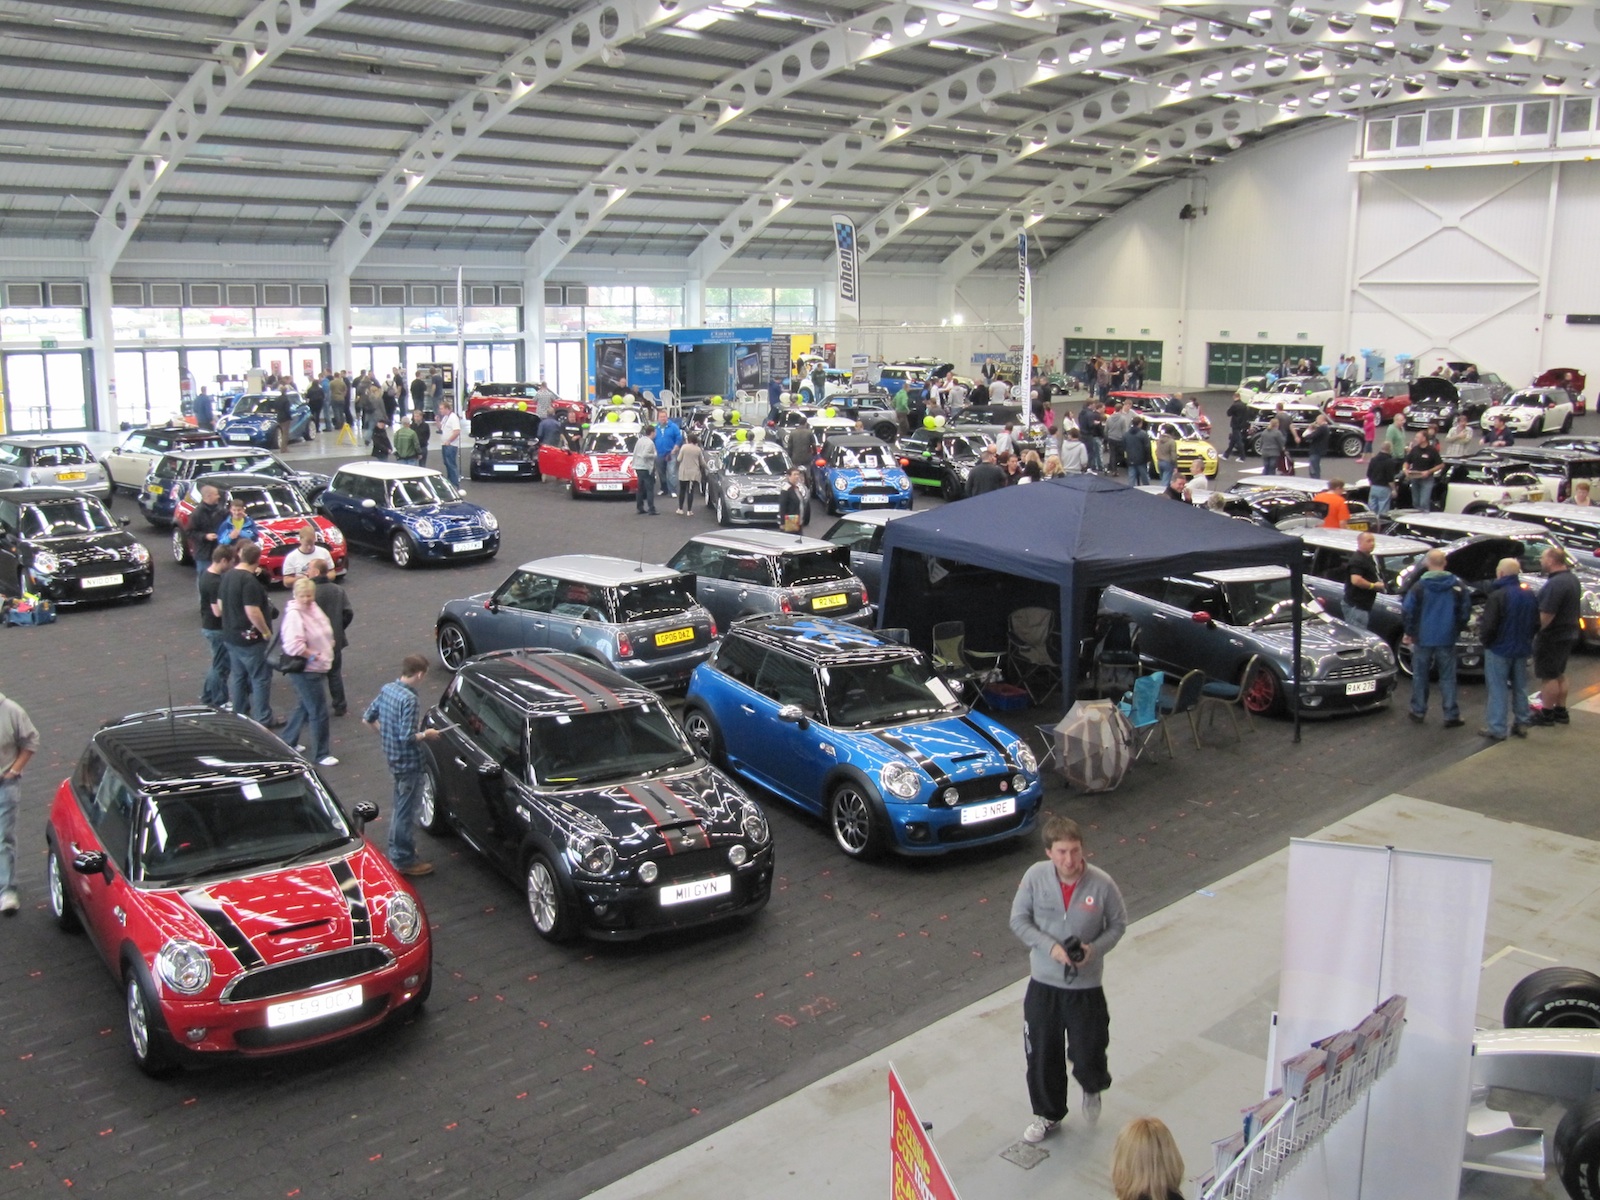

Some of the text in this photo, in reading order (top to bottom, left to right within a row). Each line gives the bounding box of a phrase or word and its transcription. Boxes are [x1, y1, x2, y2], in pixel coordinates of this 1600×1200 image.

[840, 249, 855, 302] Lohen
[660, 629, 691, 643] GP06 DAZ
[1347, 683, 1361, 692] RAK
[990, 802, 1007, 816] NRE
[694, 881, 717, 897] GYN
[277, 999, 320, 1021] ST59
[1545, 999, 1600, 1012] POTEN
[896, 1107, 931, 1185] Classic
[896, 1129, 915, 1175] Car
